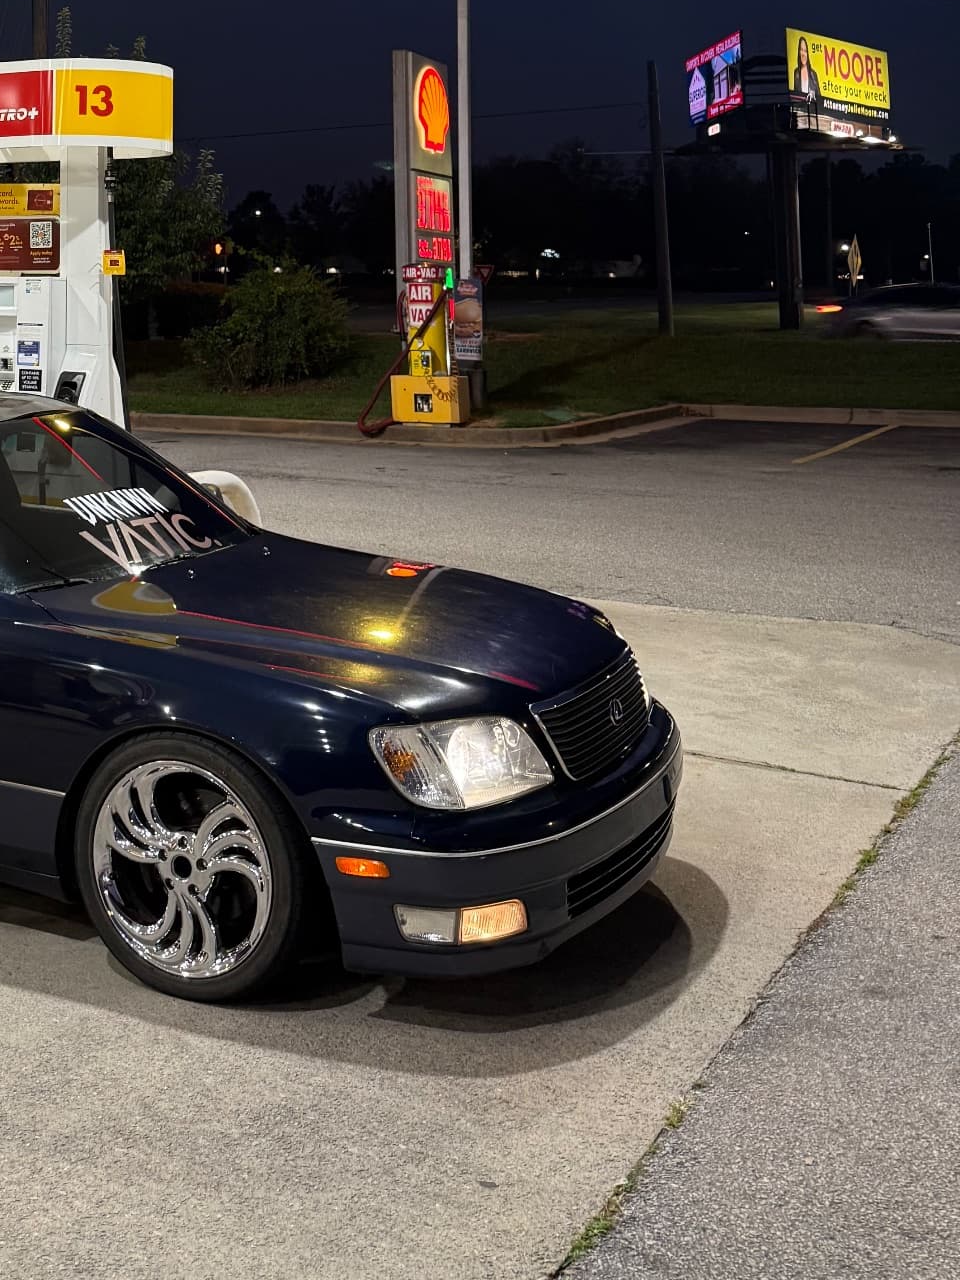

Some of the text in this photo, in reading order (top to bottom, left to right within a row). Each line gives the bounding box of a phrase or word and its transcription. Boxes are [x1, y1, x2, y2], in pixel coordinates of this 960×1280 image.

[811, 43, 884, 88] get MOORE
[75, 84, 115, 117] 13
[822, 80, 887, 103] after your wreck
[410, 285, 432, 301] AIR
